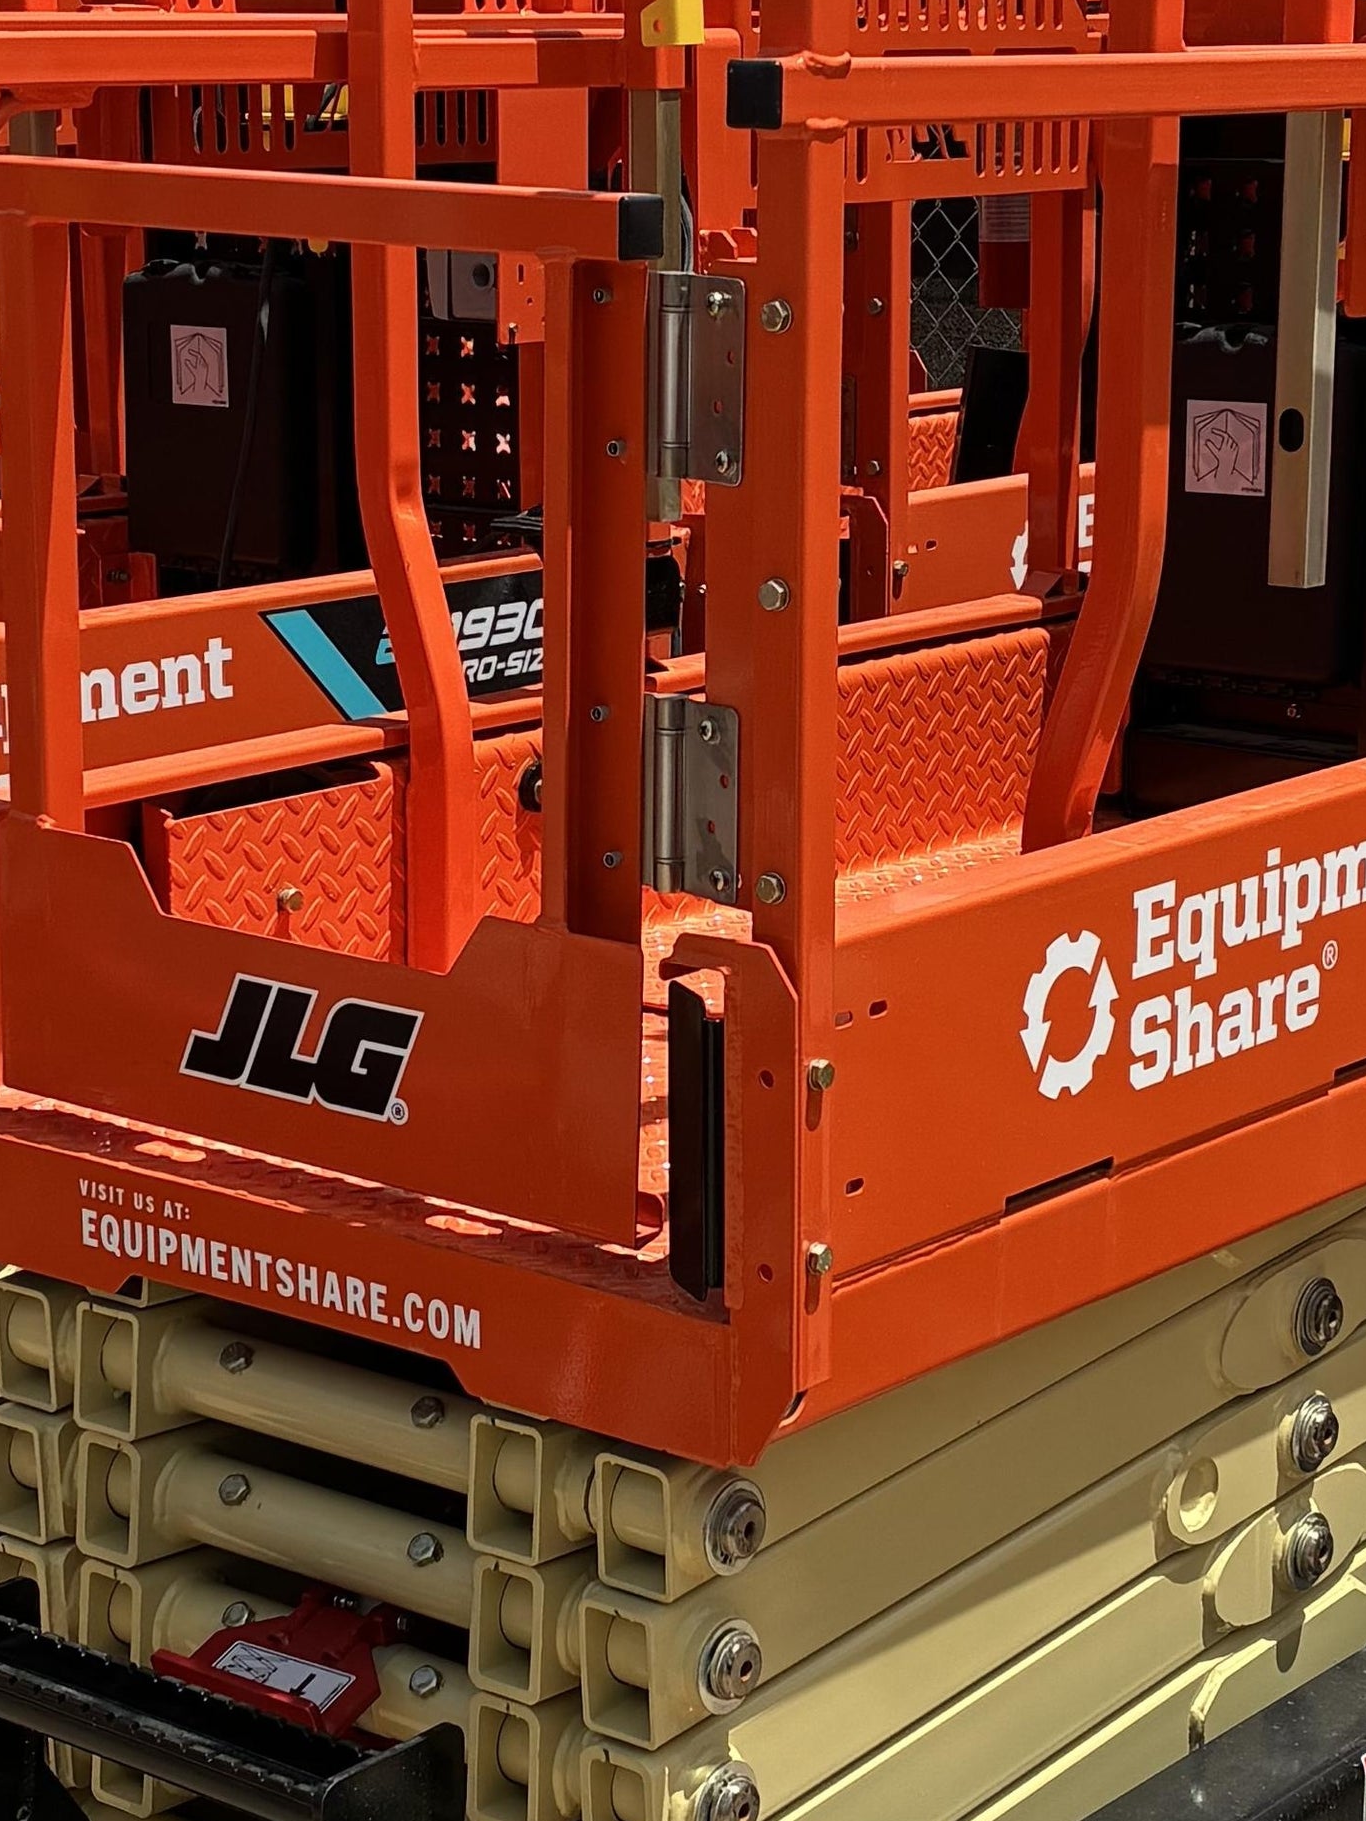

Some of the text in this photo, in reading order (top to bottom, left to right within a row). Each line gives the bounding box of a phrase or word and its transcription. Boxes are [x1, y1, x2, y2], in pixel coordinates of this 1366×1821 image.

[78, 1178, 191, 1221] VISIT US AT:
[81, 1208, 482, 1350] EQUIPMENTSHARE.COM
